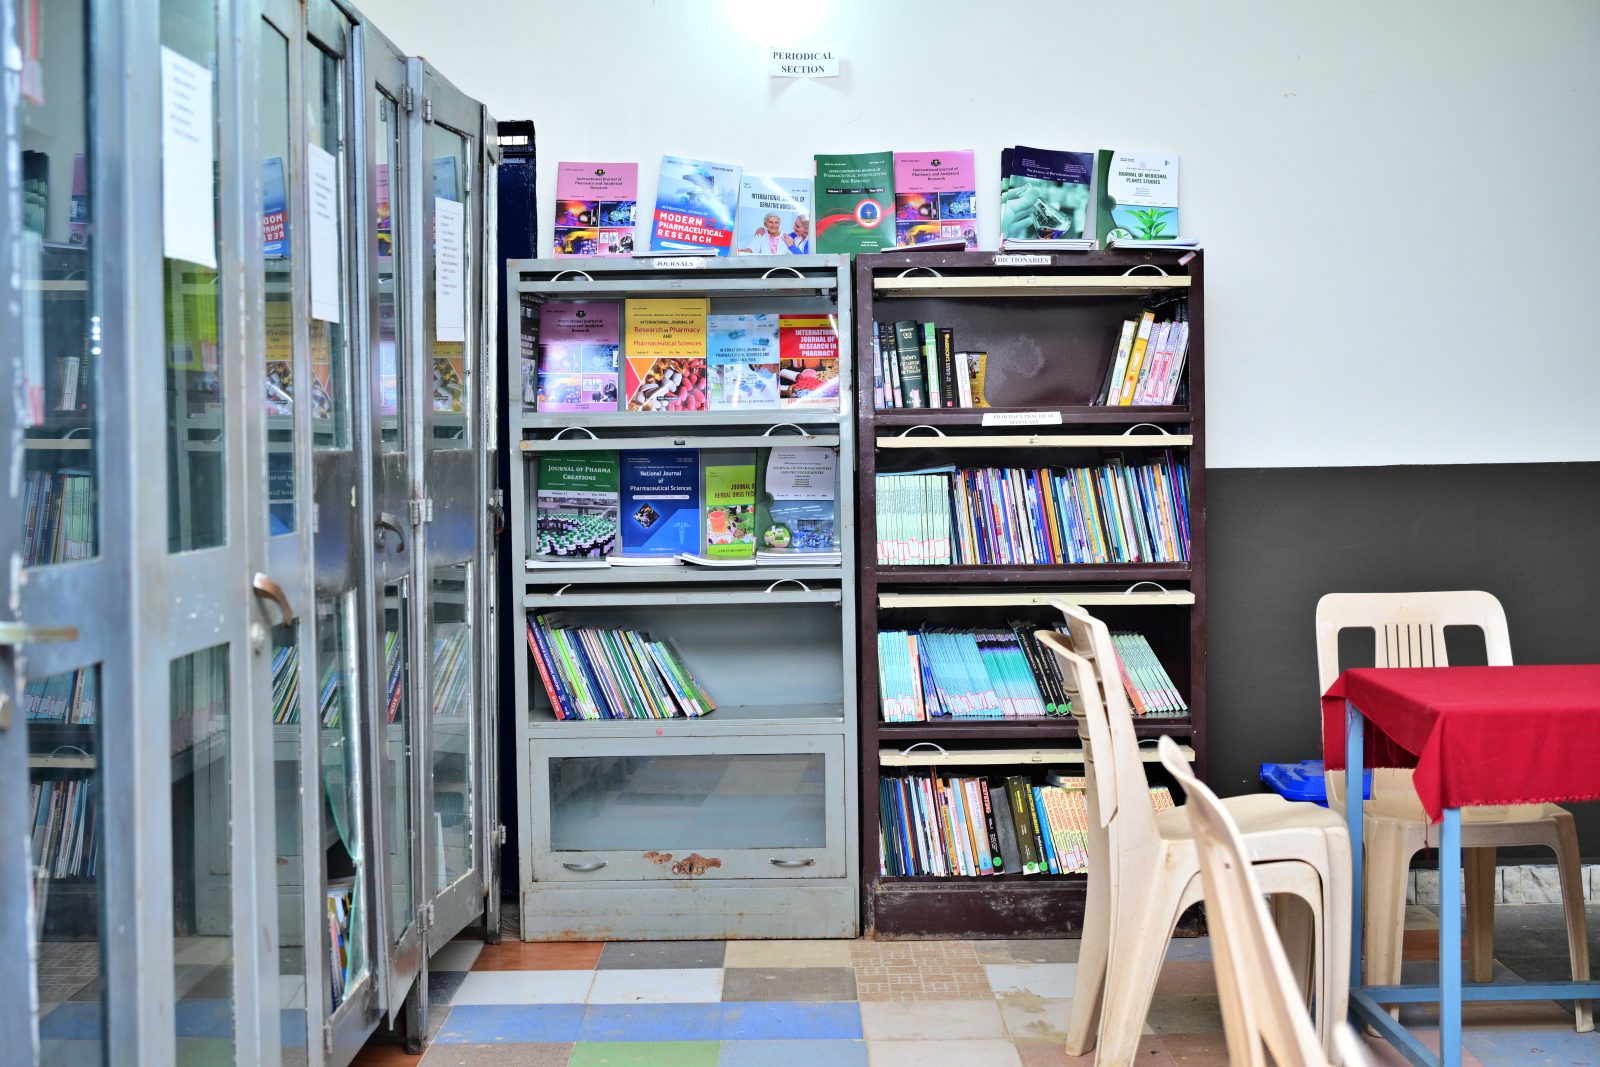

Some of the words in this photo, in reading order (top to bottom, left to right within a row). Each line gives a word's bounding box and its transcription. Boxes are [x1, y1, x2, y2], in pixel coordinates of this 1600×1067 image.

[773, 51, 834, 60] PERIODICAL
[781, 65, 824, 73] SECTION
[660, 212, 703, 226] MODERN
[658, 229, 712, 243] RESEARCH
[659, 221, 724, 238] PHARMACEUTICAL
